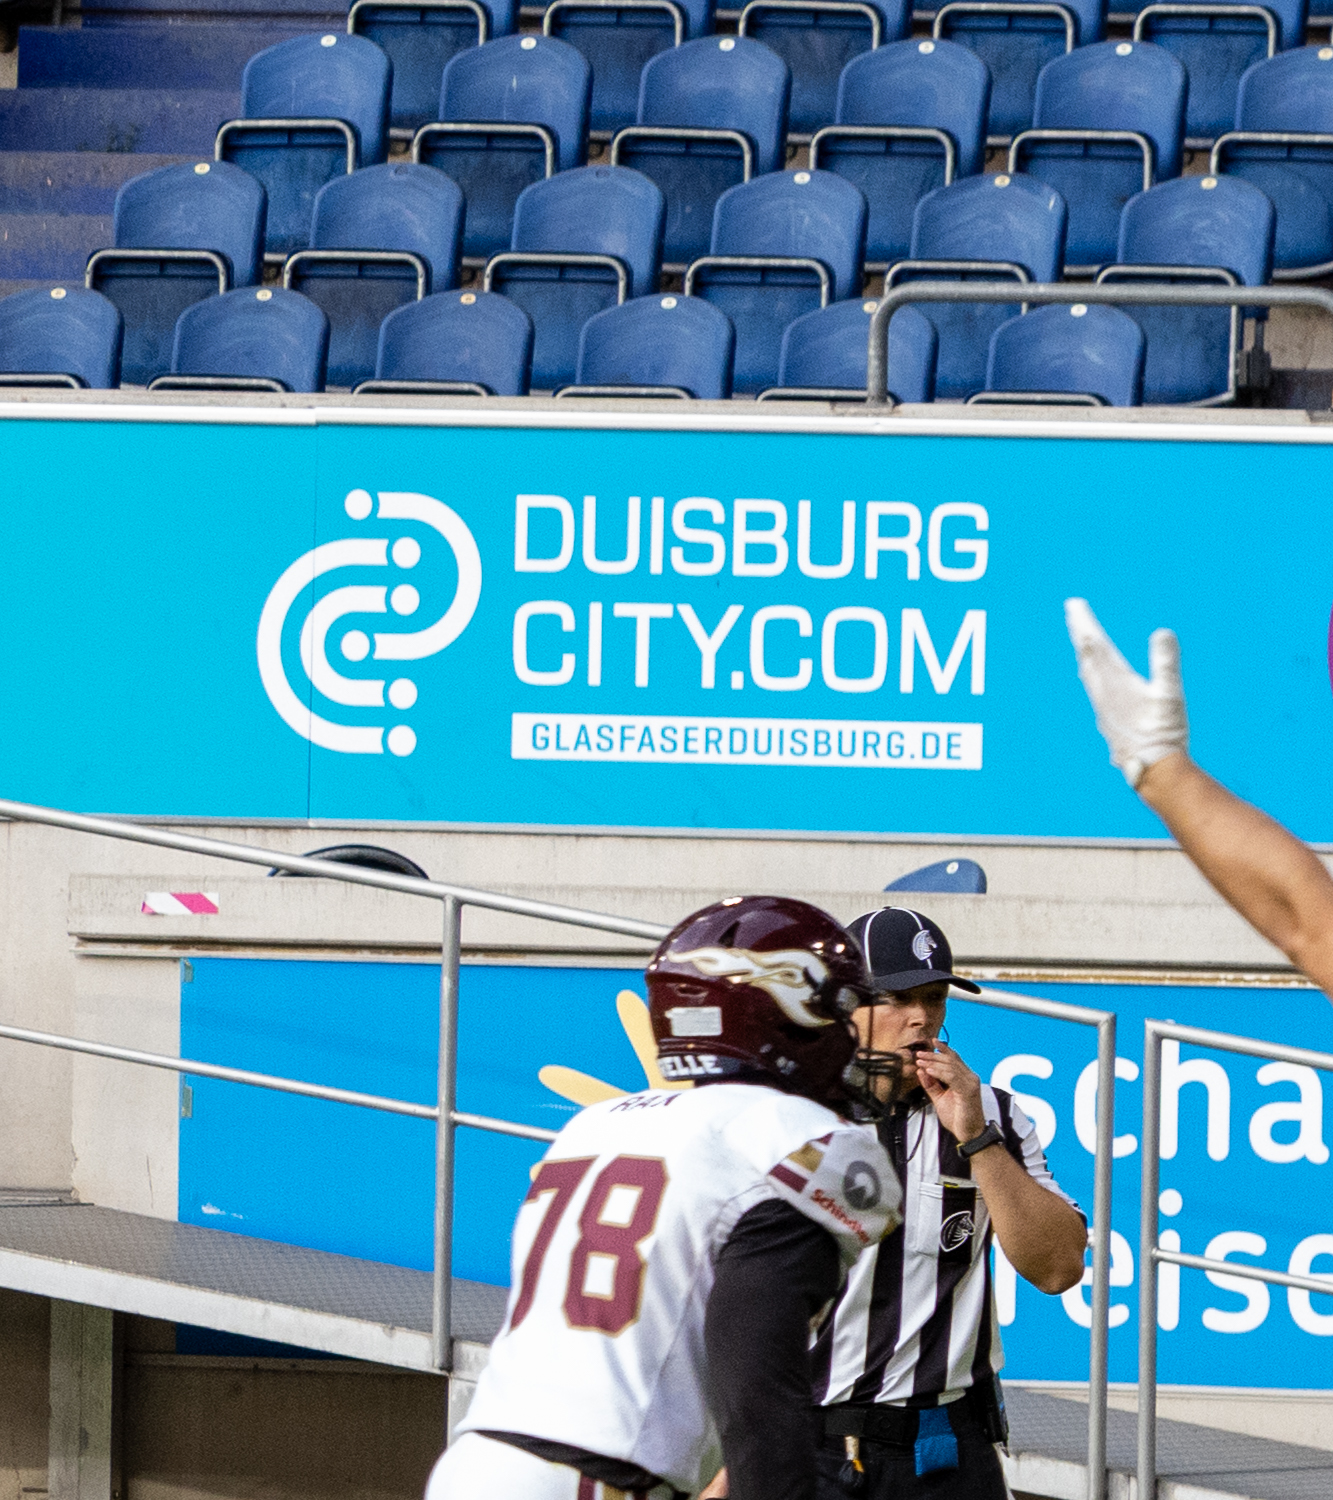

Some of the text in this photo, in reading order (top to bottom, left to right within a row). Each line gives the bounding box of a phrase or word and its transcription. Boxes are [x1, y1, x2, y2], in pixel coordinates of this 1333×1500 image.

[514, 494, 990, 582] DUISBURG
[512, 600, 988, 696] CITY.COM
[530, 723, 963, 763] GLASFASERDUISBURG.DE
[508, 1153, 671, 1339] 78
